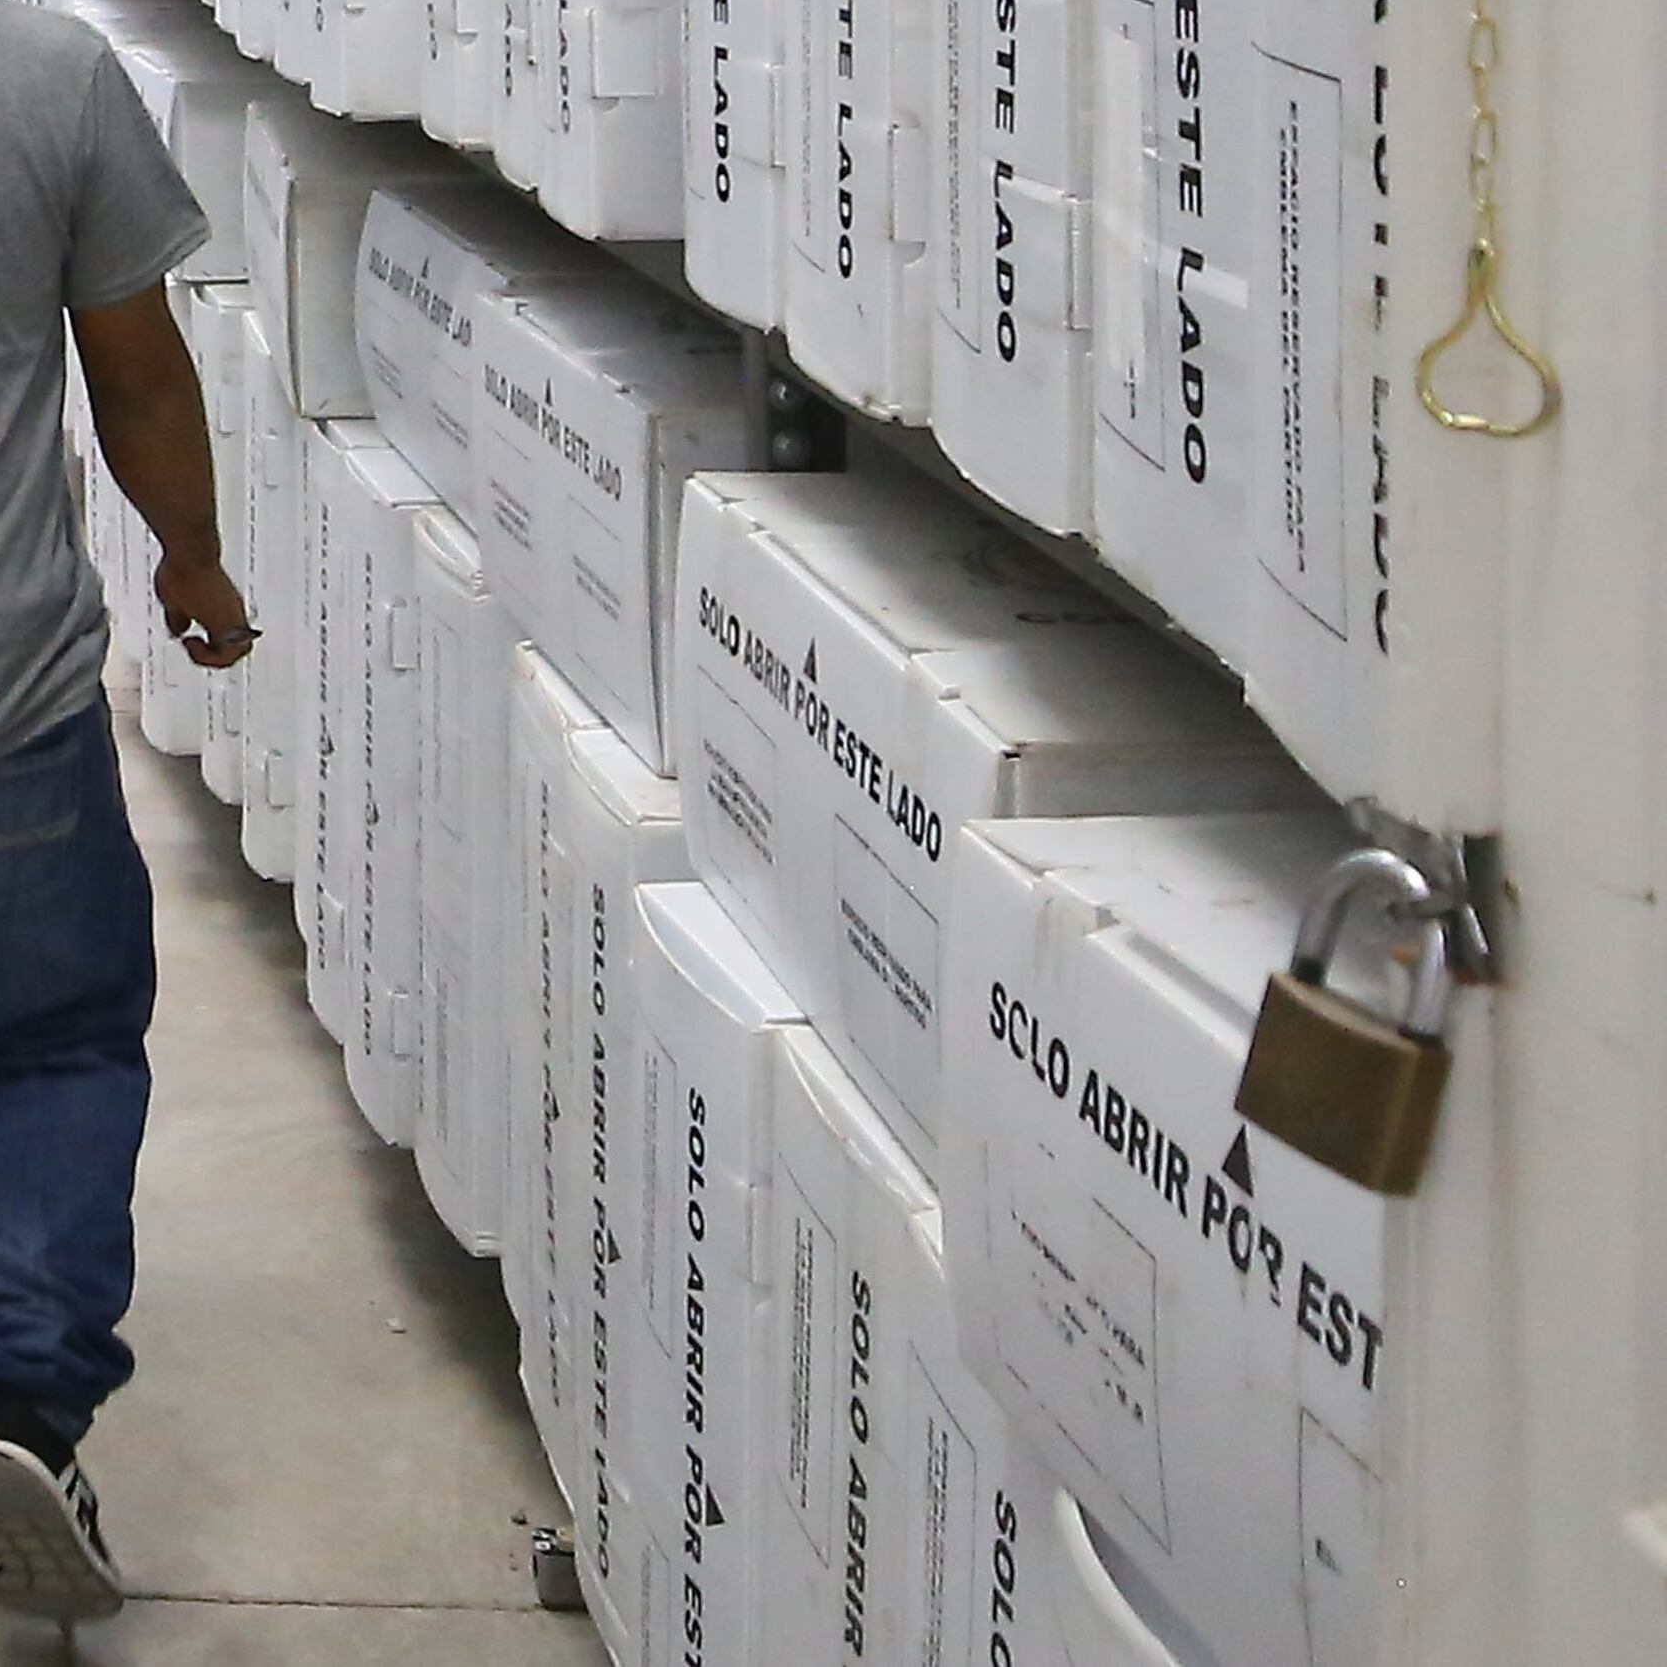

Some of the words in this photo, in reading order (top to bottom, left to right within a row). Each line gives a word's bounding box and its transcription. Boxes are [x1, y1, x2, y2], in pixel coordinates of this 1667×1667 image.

[712, 45, 730, 203] LADO
[837, 103, 853, 279] LADO
[993, 160, 1016, 362] LADO
[1178, 248, 1206, 483] LADO
[699, 587, 741, 657] SOLO
[743, 630, 791, 711] ABRIR
[794, 680, 830, 752] POR
[833, 719, 883, 804] ESTE
[886, 771, 942, 863] LADO
[592, 884, 605, 1016] SOLO
[592, 1033, 606, 1184] ABRIR
[686, 1087, 705, 1242] SOLO
[592, 1196, 606, 1299] POR
[1079, 1071, 1190, 1217] ABRIR
[1201, 1177, 1284, 1307] POR
[1296, 1264, 1382, 1390] EST
[593, 1310, 607, 1438] ESTE
[685, 1253, 704, 1433] ABRIR
[848, 1271, 870, 1444] SOLO
[594, 1447, 609, 1579] LADO
[683, 1444, 703, 1564] POR
[843, 1456, 867, 1656] ABRIR
